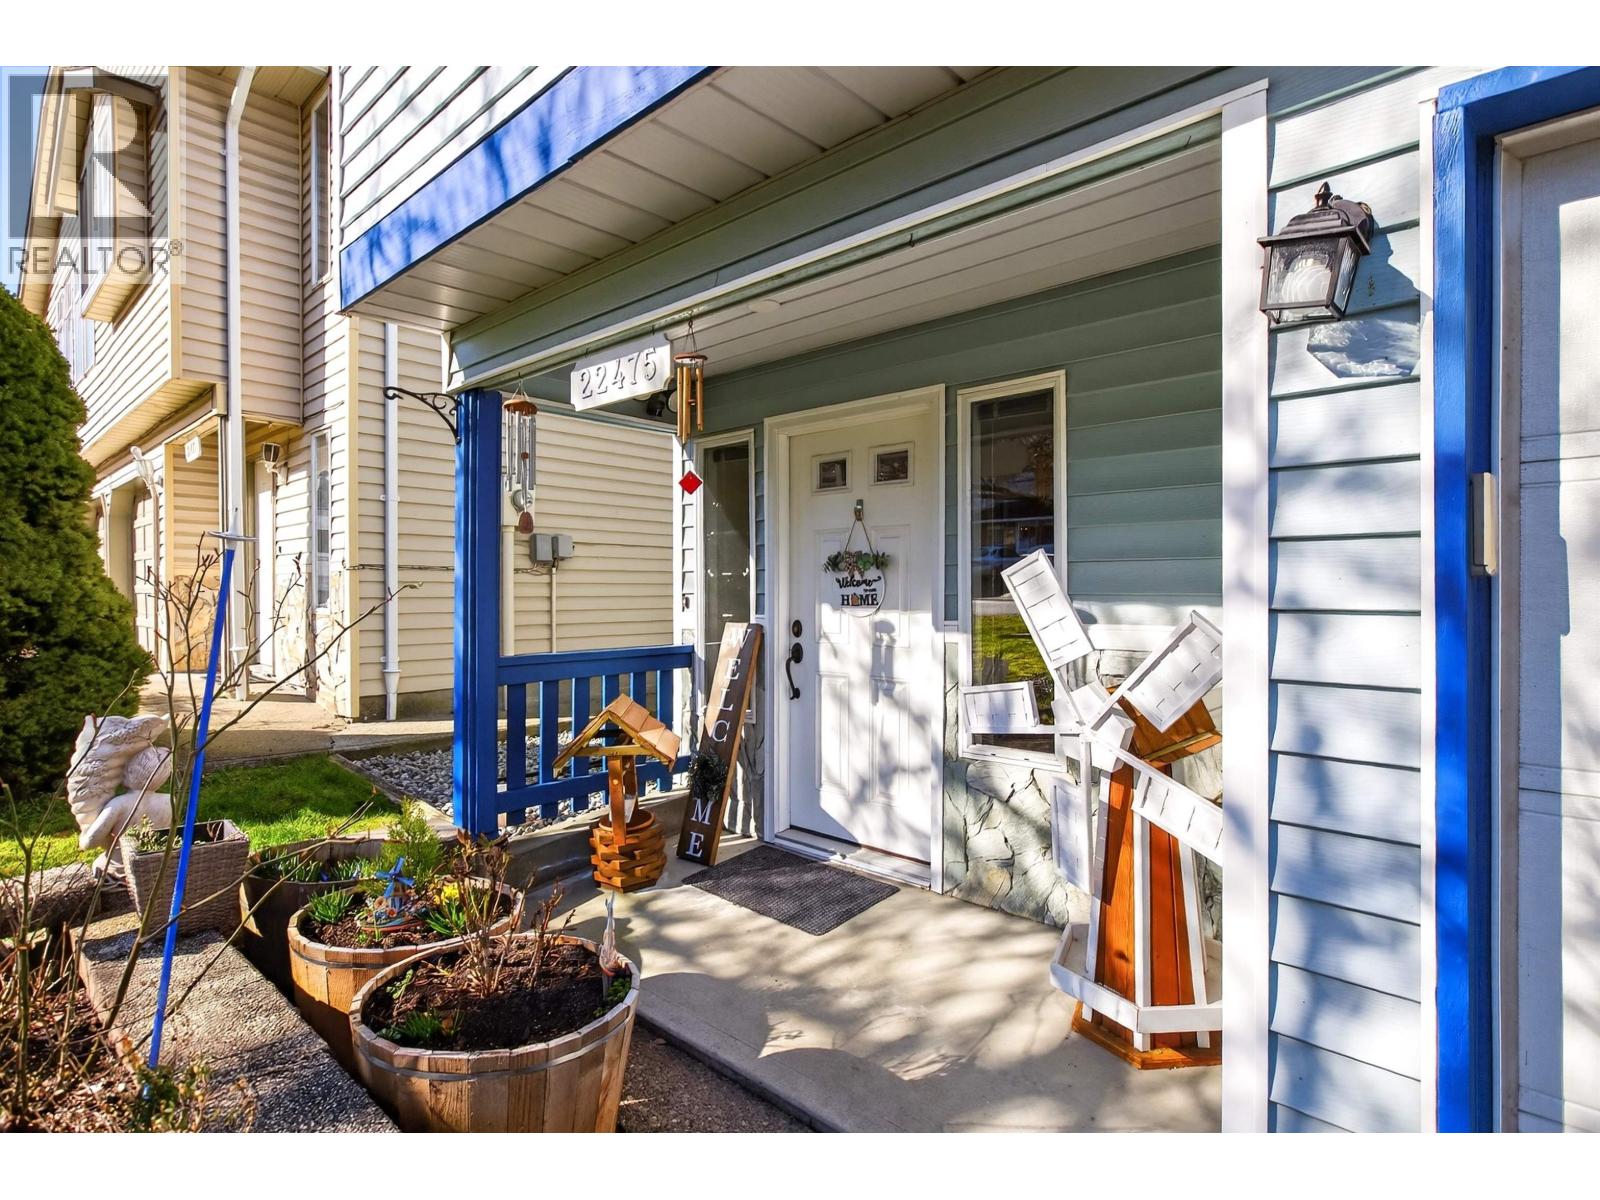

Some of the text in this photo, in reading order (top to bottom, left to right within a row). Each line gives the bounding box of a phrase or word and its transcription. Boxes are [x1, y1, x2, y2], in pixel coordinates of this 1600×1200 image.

[580, 347, 657, 399] 22475
[836, 576, 881, 588] Welcome
[841, 594, 879, 606] HME
[687, 628, 751, 857] WELCME
